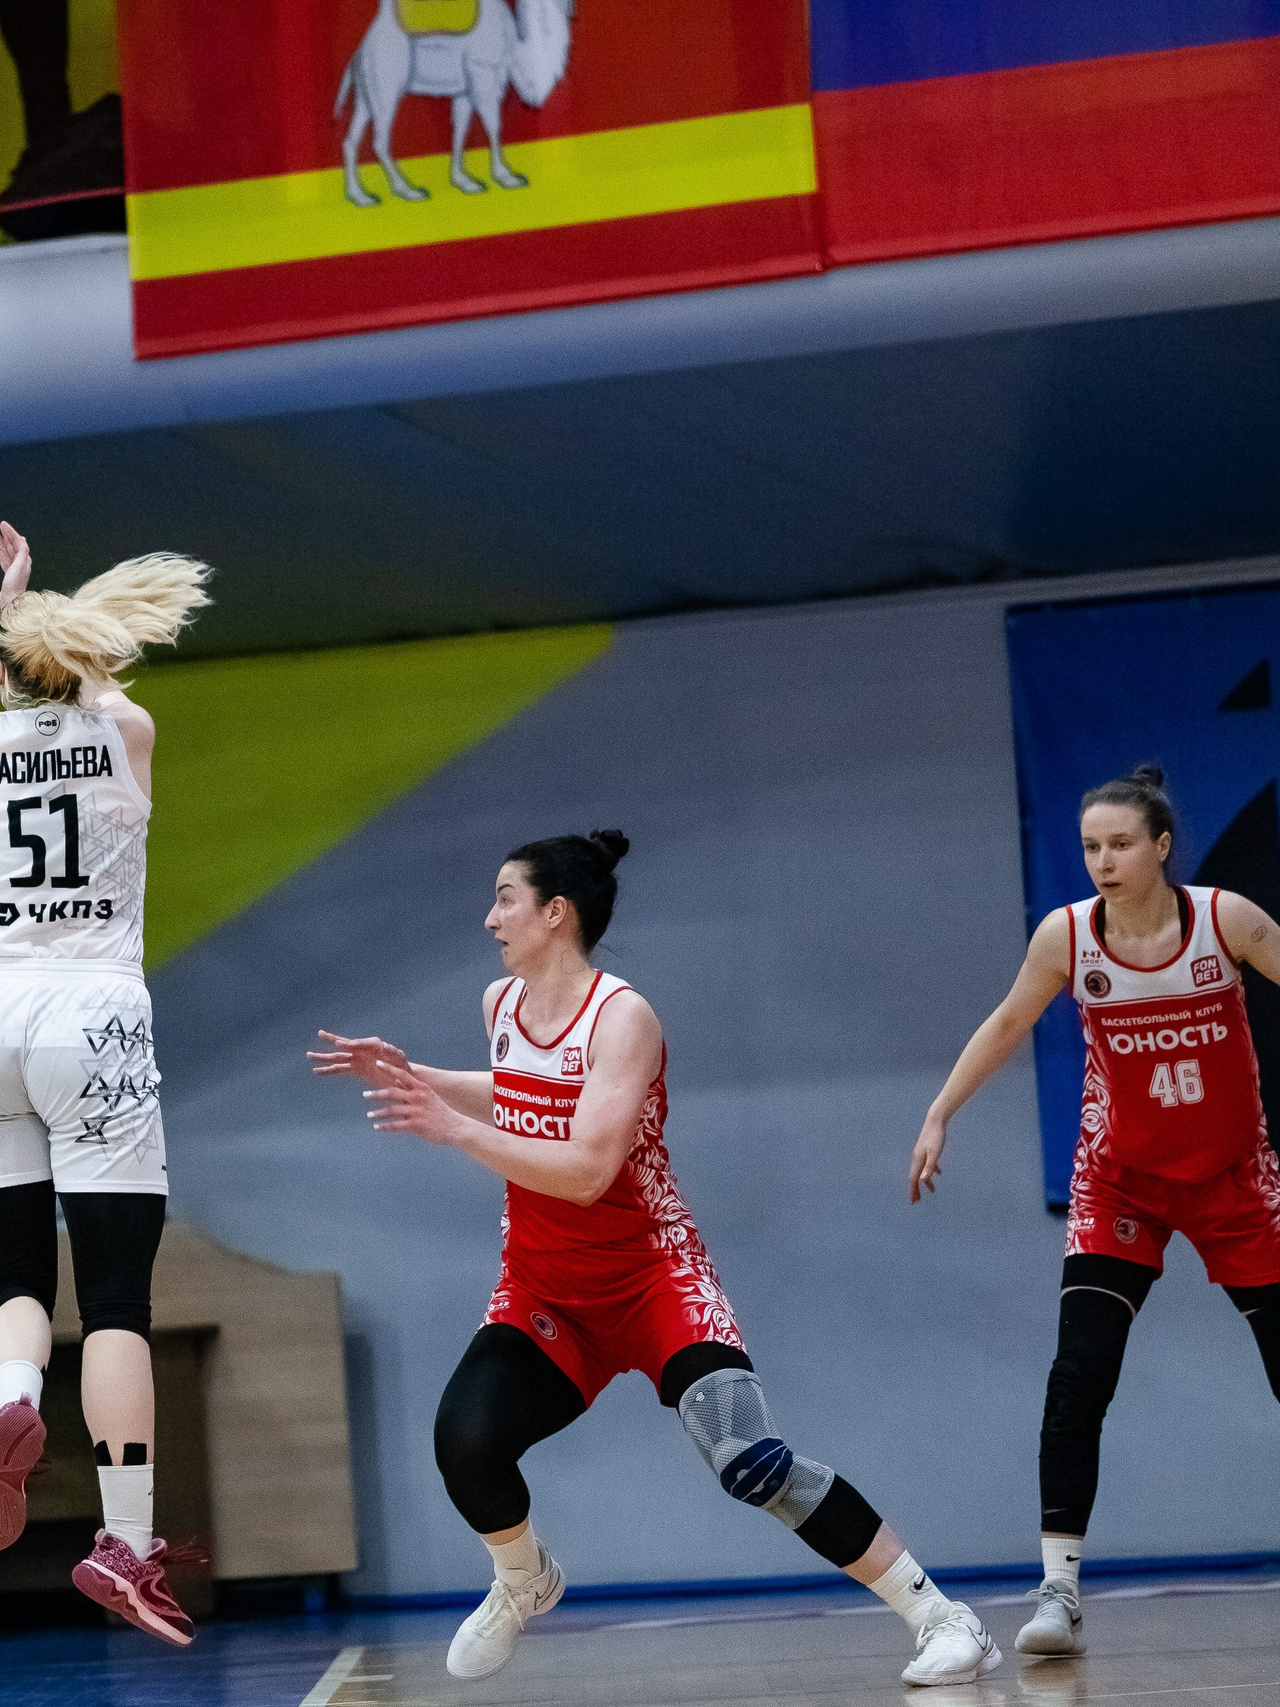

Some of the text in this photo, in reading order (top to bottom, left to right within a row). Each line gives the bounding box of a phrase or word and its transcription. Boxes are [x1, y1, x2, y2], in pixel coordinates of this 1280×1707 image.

[38, 719, 58, 727] РФБ
[7, 794, 90, 888] 51
[28, 898, 113, 923] ЧКПЗ
[1194, 958, 1217, 974] FON
[1195, 968, 1219, 984] BET
[1101, 1002, 1223, 1027] БАСКЕТБОЛЬНЫЙ КЛУБ
[1106, 1021, 1228, 1055] ЮНОСТЬ
[562, 1060, 581, 1072] BET
[564, 1050, 581, 1061] FON
[1149, 1059, 1205, 1107] 46
[493, 1101, 570, 1139] ЮНОСТ
